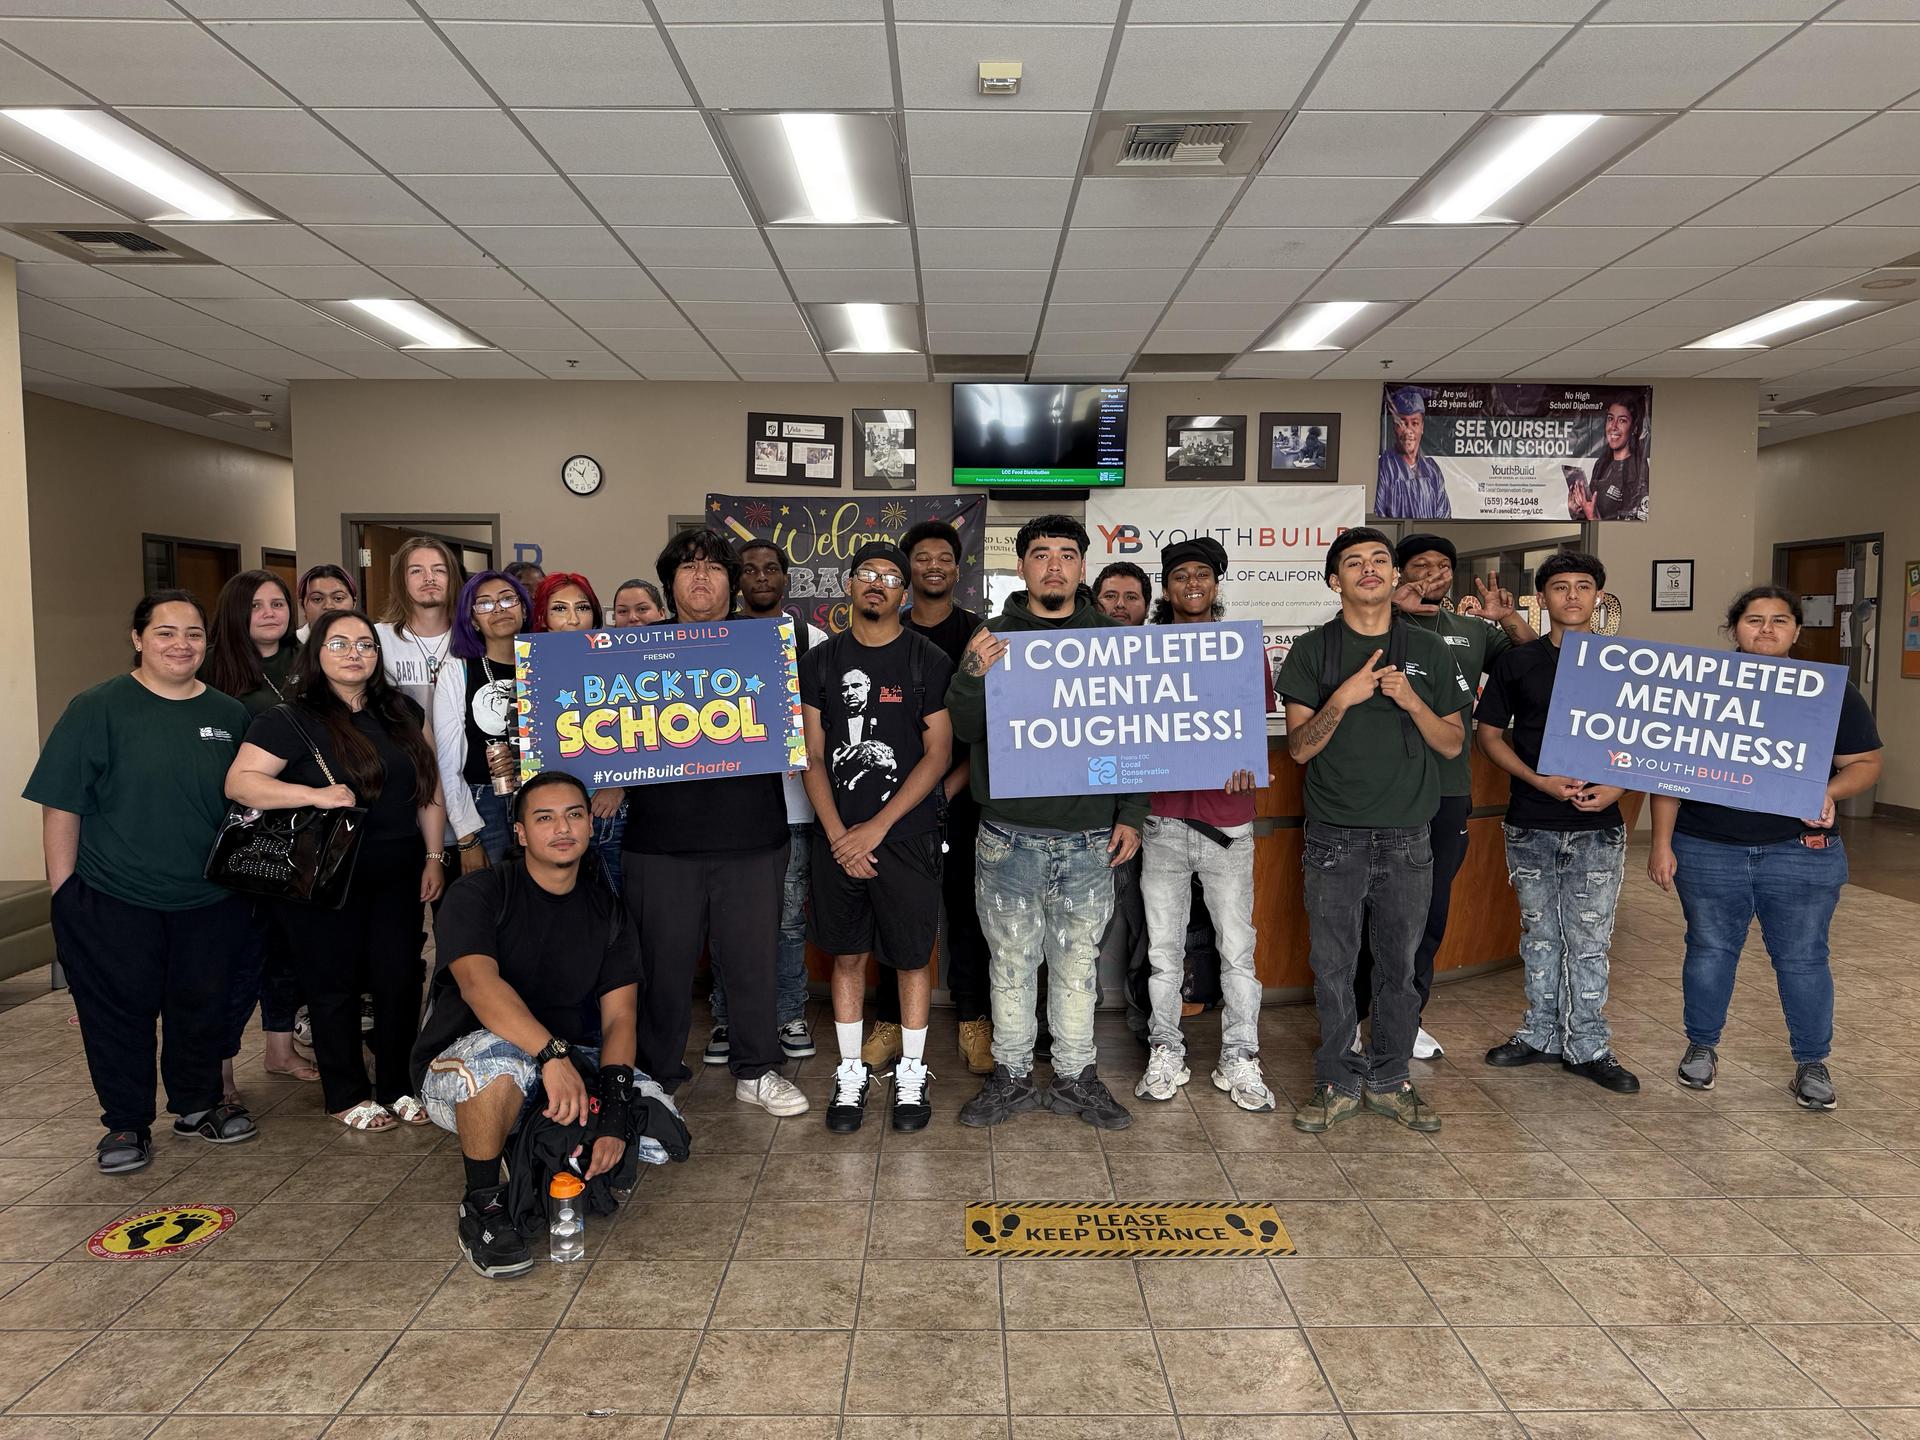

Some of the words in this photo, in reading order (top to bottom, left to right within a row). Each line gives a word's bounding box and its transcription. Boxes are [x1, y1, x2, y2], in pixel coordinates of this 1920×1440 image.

[1442, 390, 1454, 398] Are
[1455, 391, 1468, 400] you
[1564, 391, 1574, 400] No
[1575, 392, 1590, 401] High
[1427, 400, 1448, 408] 18-29
[1448, 401, 1467, 410] years
[1468, 400, 1483, 409] old?
[1549, 401, 1572, 410] School
[1573, 402, 1603, 411] Diploma?
[1454, 420, 1486, 438] SEE
[1490, 420, 1574, 439] YOURSELF
[1454, 439, 1495, 455] BACK
[1498, 439, 1511, 455] IN
[1517, 439, 1574, 456] SCHOOL
[1491, 465, 1535, 476] YouthBuild
[1484, 497, 1503, 506] (559)
[1504, 497, 1539, 506] 264-1048
[772, 502, 908, 564] Welco
[1096, 524, 1144, 554] YB
[787, 567, 851, 599] BA
[1236, 570, 1255, 582] OF
[1258, 570, 1326, 582] CALIFORN
[1231, 599, 1250, 607] social
[1250, 600, 1270, 609] justice
[1271, 599, 1284, 607] and
[1285, 600, 1322, 609] community
[585, 632, 612, 650] YB
[614, 627, 730, 645] YOUTHBUILD
[643, 652, 676, 662] FRESNO
[1002, 643, 1012, 671] I
[1024, 630, 1245, 670] COMPLETED
[396, 660, 418, 684] BABY,
[1576, 640, 1588, 667] I
[1599, 644, 1825, 698] COMPLETED
[582, 669, 685, 707] BACK
[685, 668, 742, 699] TO
[1052, 672, 1199, 709] MENTAL
[1615, 682, 1765, 729] MENTAL
[555, 696, 768, 759] SCHOOL
[1009, 709, 1243, 750] TOUGHNESS!
[1570, 709, 1807, 772] TOUGHNESS!
[593, 760, 742, 785] #YouthBuildCharter
[1121, 768, 1170, 776] Conservation
[1607, 749, 1633, 768] YB
[1635, 756, 1754, 785] YOUTHBUILD
[1121, 777, 1144, 785] Corps
[1658, 782, 1691, 794] FRESNO
[1076, 1213, 1171, 1227] PLEASE
[1026, 1228, 1091, 1241] KEEP
[1097, 1227, 1231, 1241] DISTANCE
